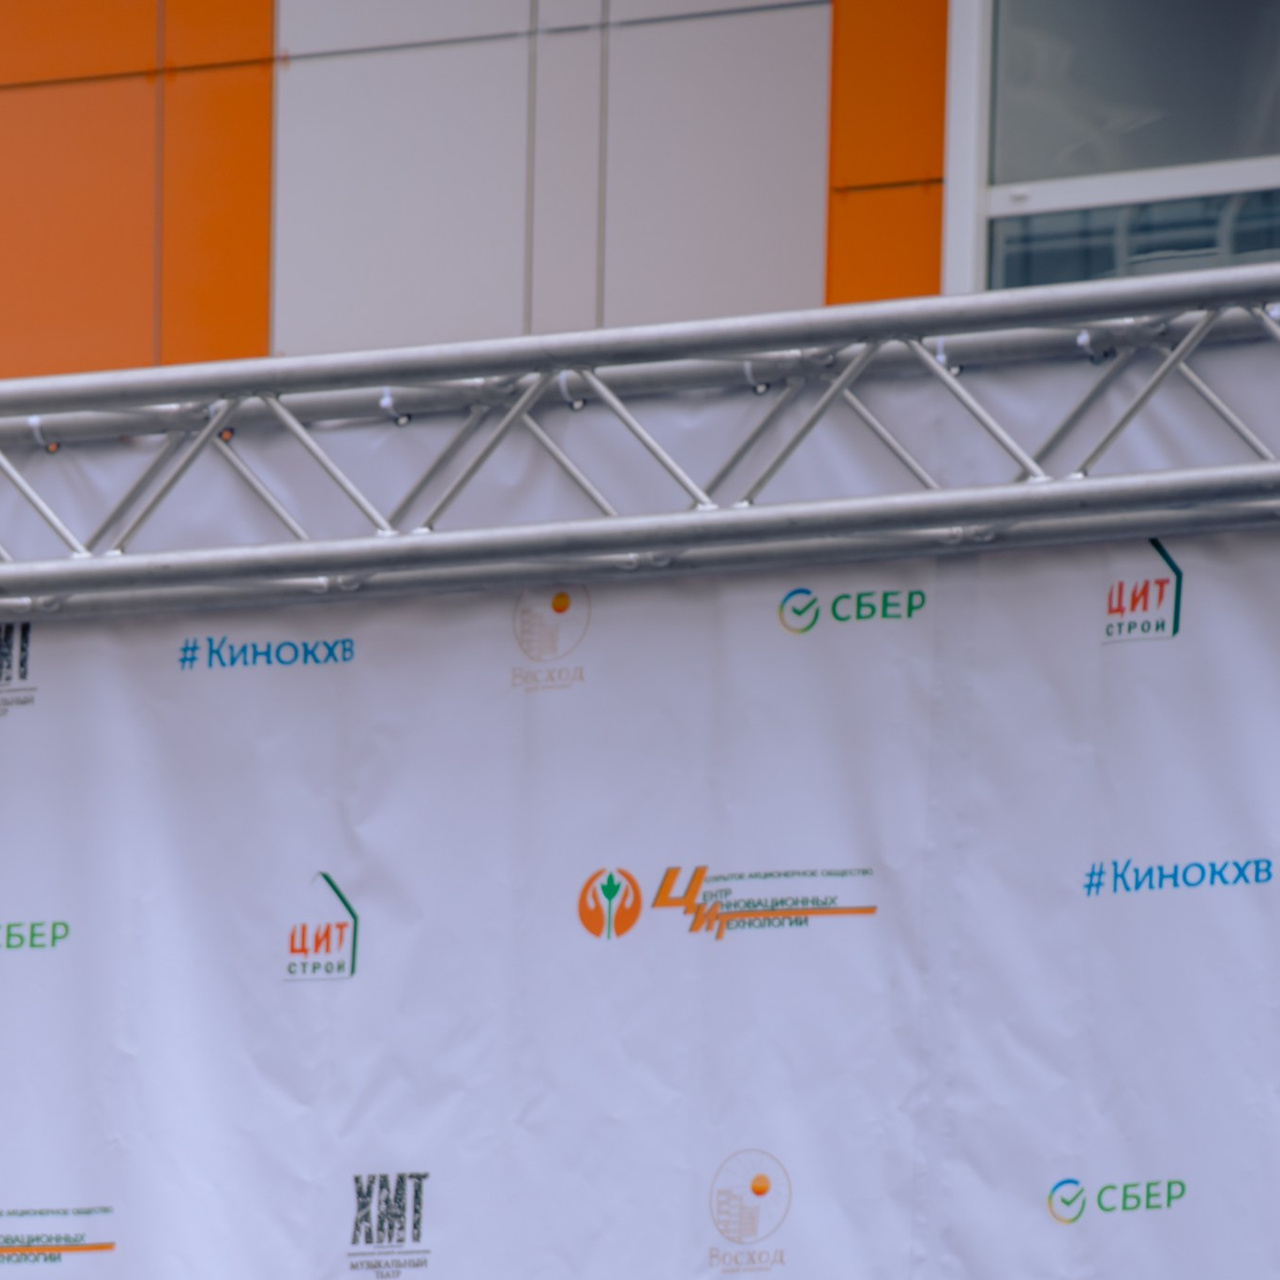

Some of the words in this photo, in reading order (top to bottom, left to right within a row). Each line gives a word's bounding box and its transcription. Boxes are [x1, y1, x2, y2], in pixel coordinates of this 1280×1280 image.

[830, 590, 926, 622] СБЕР
[1106, 578, 1171, 616] ЦИТ
[1105, 619, 1167, 637] СТРОЙ
[288, 922, 350, 957] ЦИТ
[287, 958, 347, 975] СТРОЙ
[1096, 1179, 1187, 1212] СБЕР
